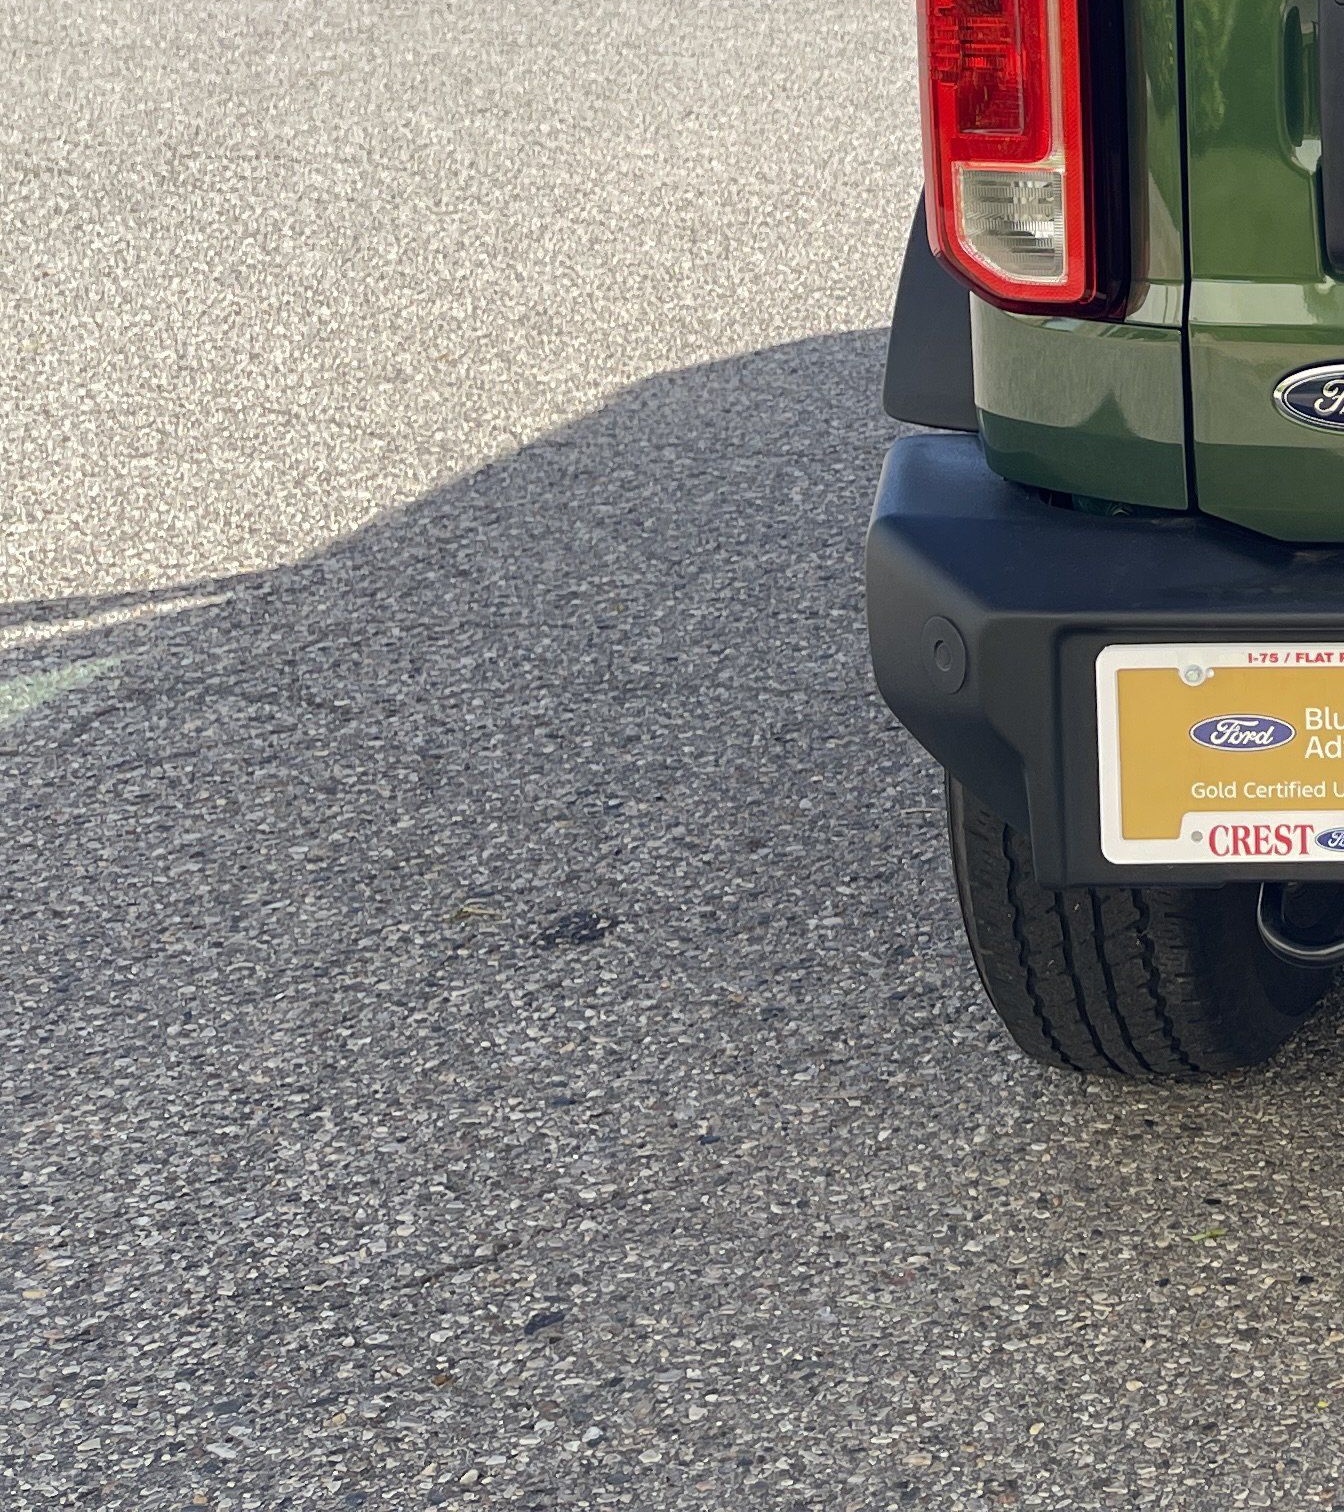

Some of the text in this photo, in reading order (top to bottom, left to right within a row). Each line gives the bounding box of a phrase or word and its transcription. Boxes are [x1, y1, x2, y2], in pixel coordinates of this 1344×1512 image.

[1247, 652, 1279, 663] I-75
[1295, 652, 1335, 663] FLAT
[1210, 719, 1274, 746] Ford
[1191, 782, 1236, 799] Gold
[1243, 781, 1326, 798] Certified
[1208, 824, 1315, 857] CREST
